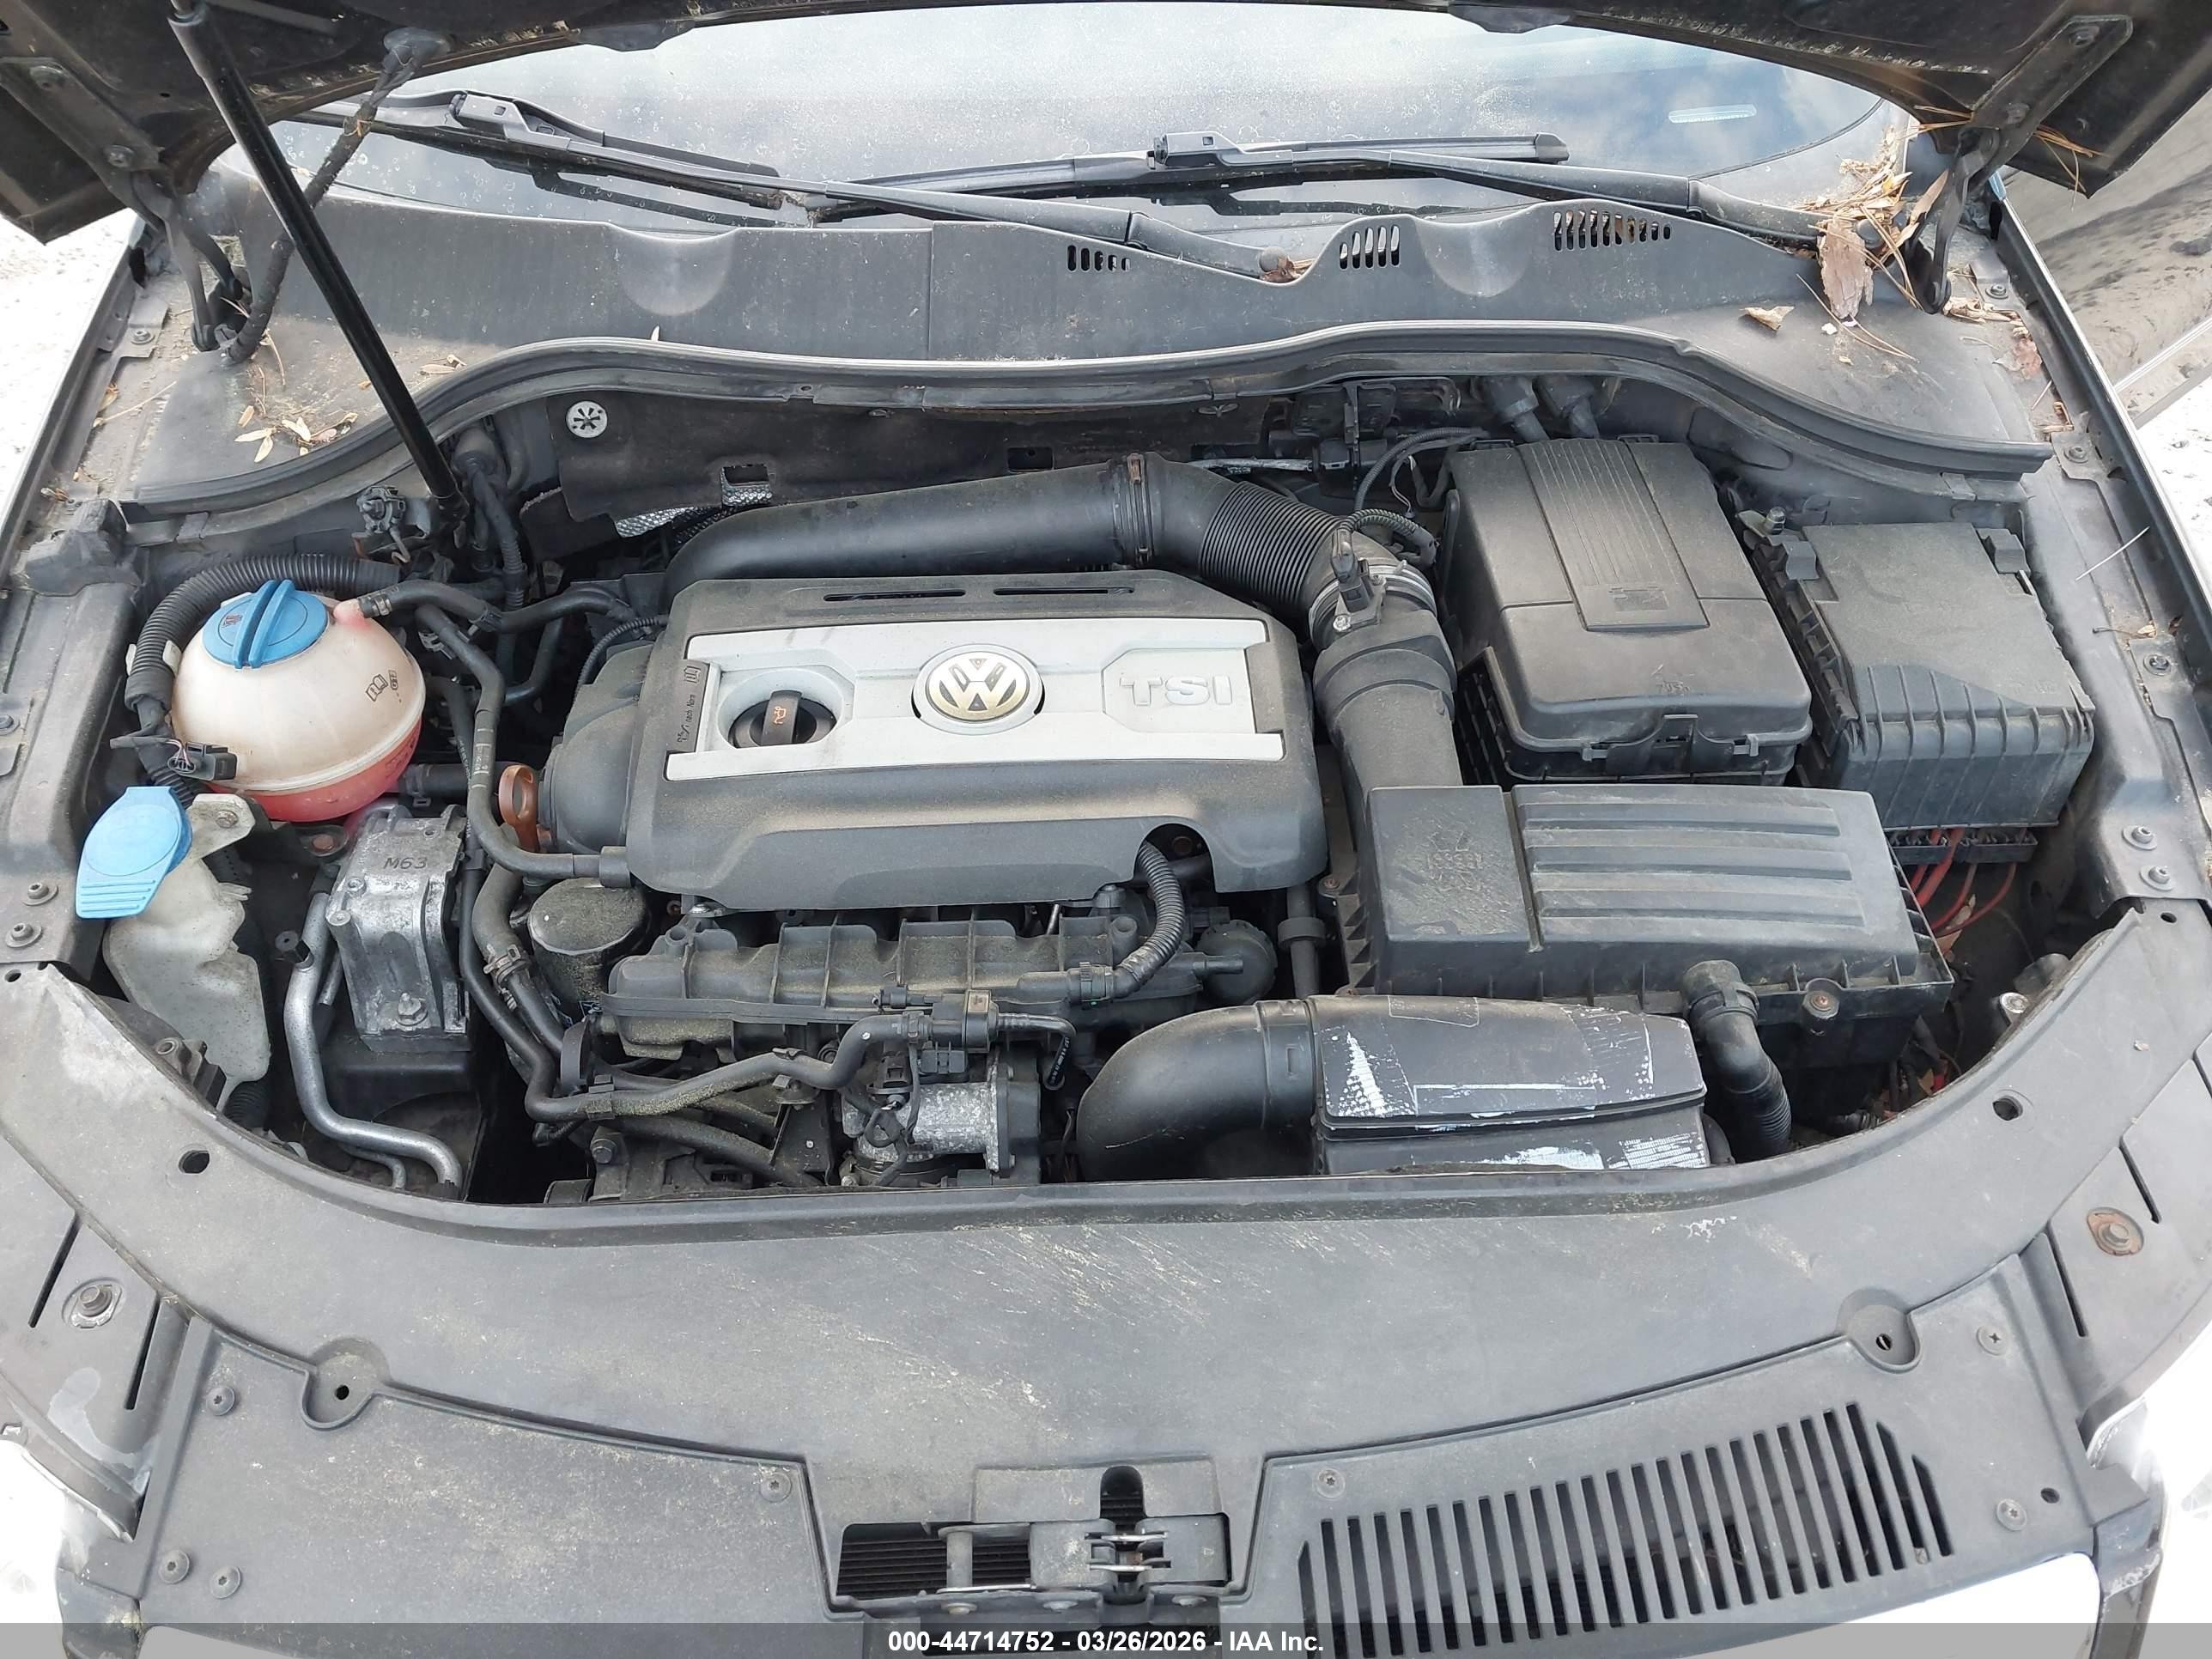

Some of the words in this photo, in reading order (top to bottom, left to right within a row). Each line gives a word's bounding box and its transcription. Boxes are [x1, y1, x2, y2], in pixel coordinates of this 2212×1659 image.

[926, 651, 1030, 721] VW
[1118, 674, 1233, 706] TSI
[383, 857, 428, 870] M63
